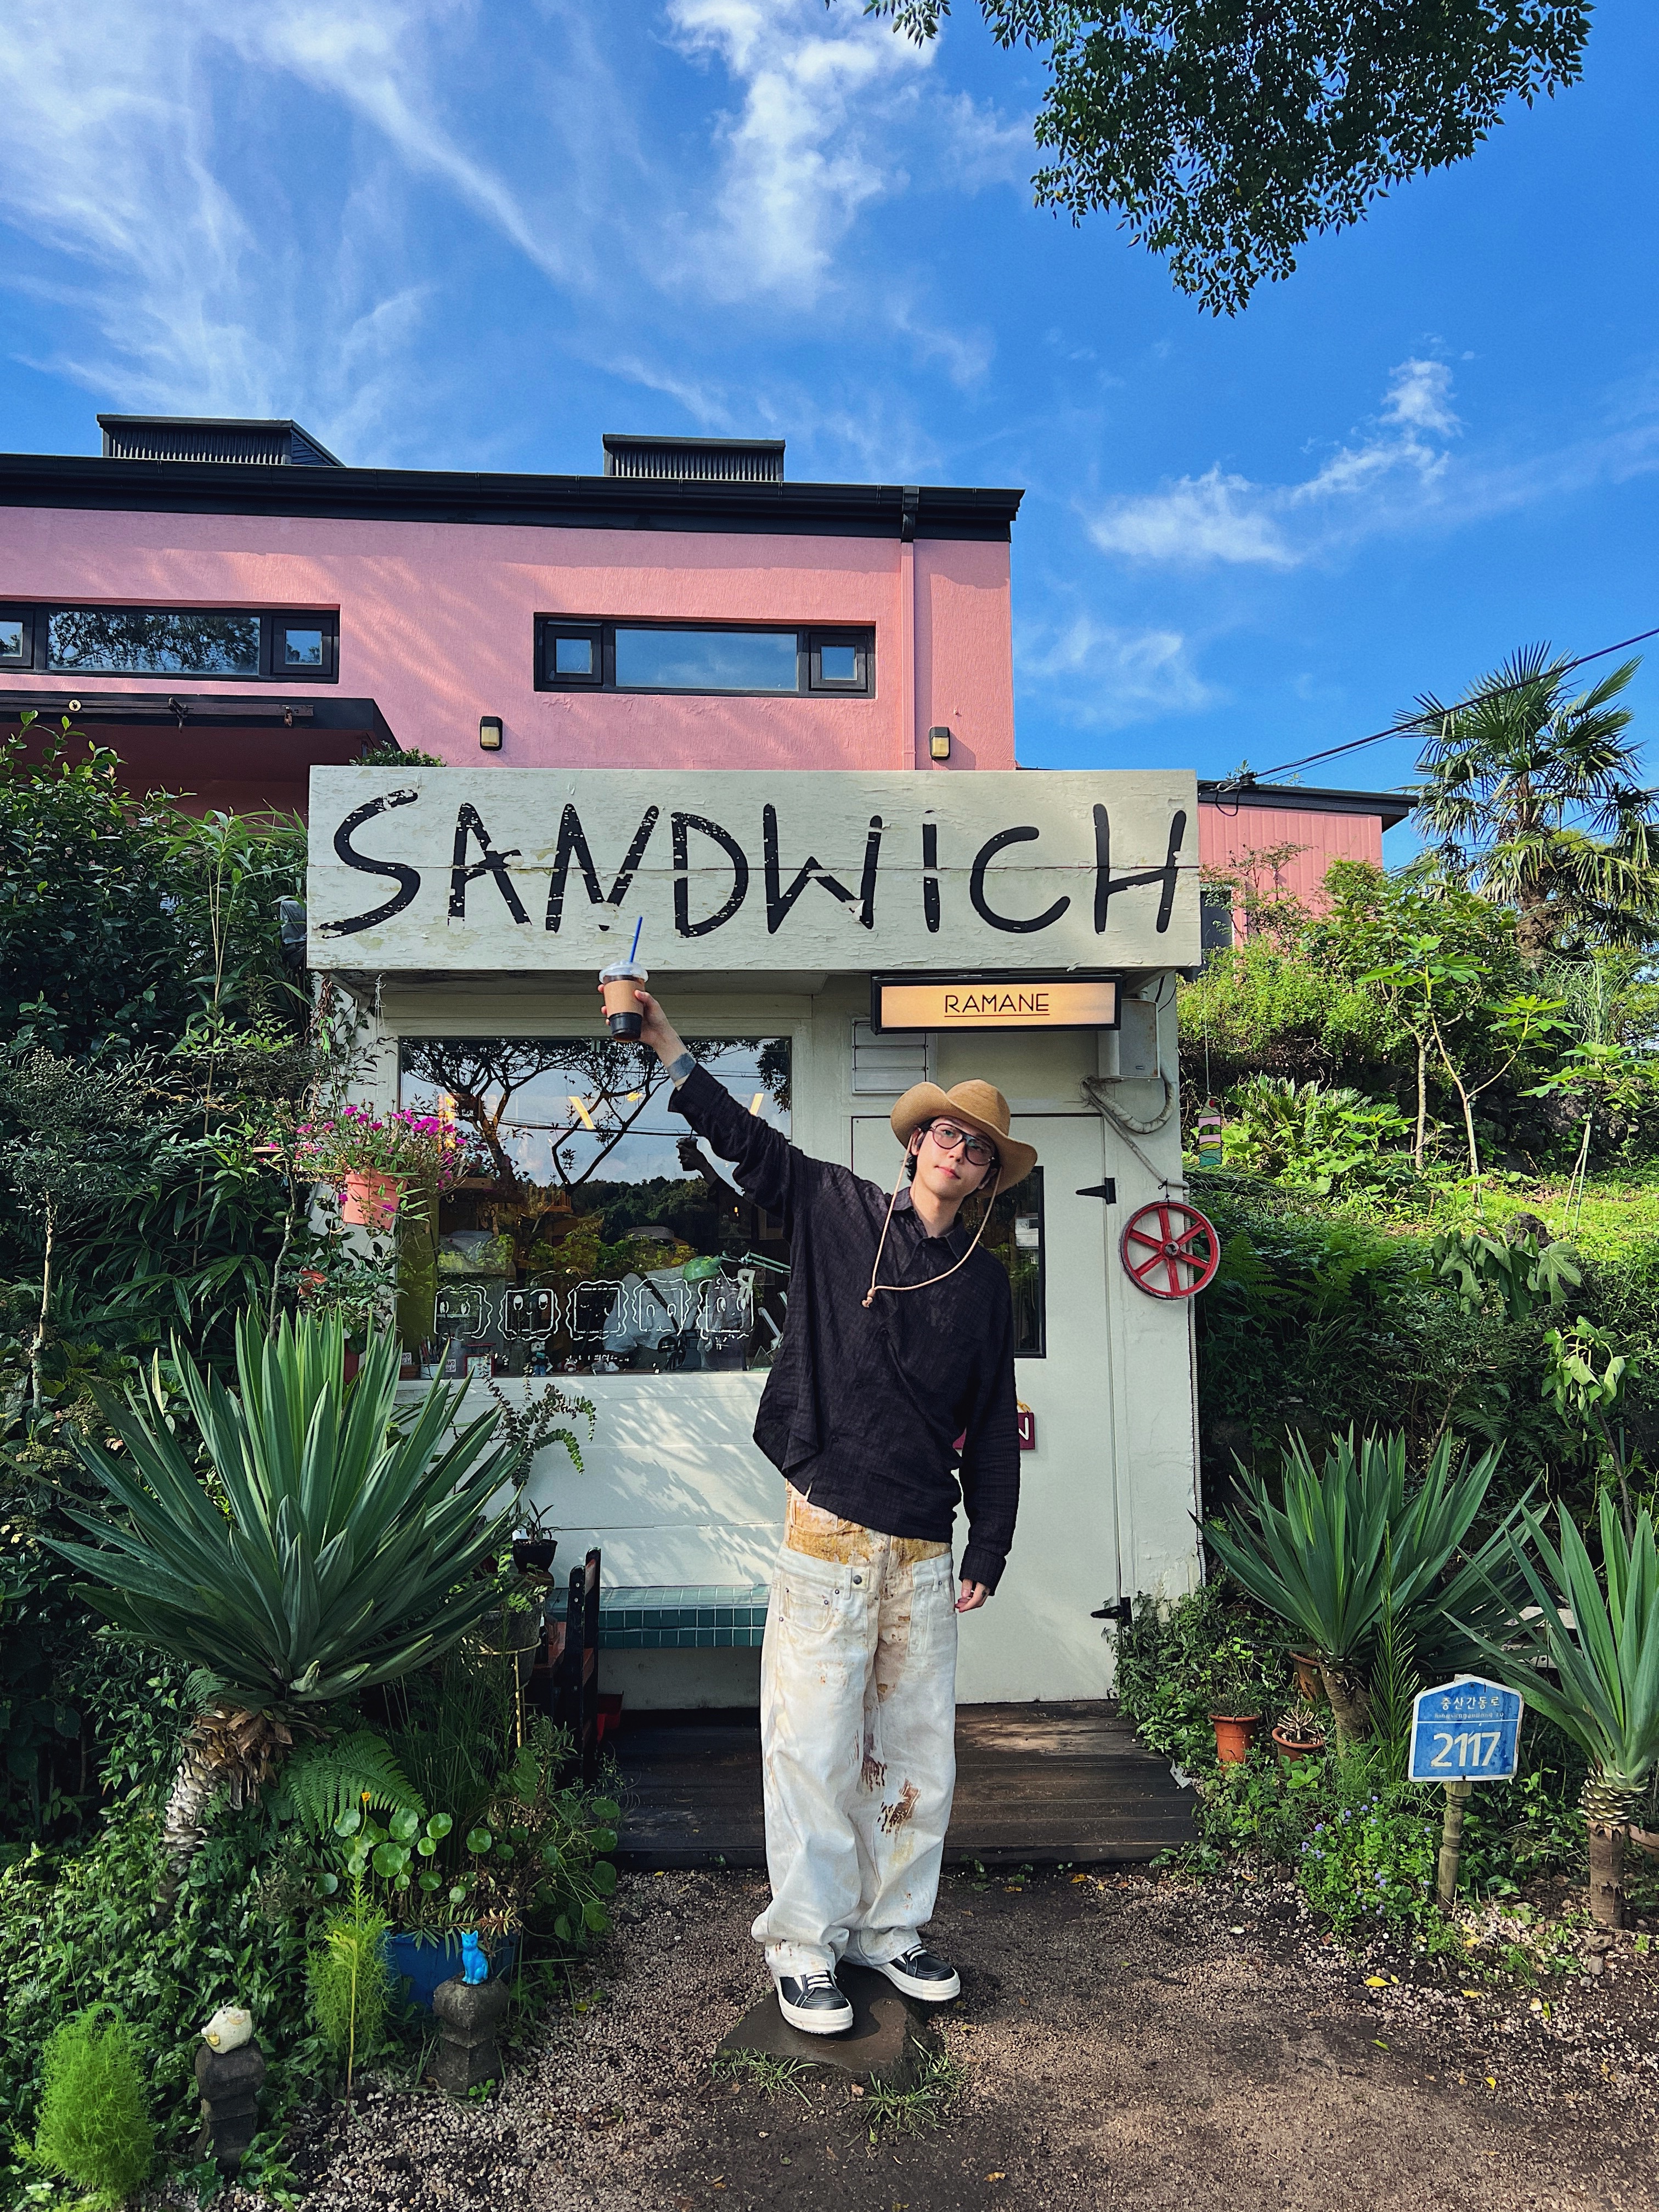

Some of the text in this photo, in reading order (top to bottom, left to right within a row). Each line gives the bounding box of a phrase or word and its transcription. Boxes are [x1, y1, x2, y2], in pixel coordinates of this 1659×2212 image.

[319, 788, 1186, 939] SANDWICH
[945, 993, 1049, 1013] RAMANE
[1441, 1696, 1500, 1711] 중산간동로
[1430, 1732, 1501, 1767] 2117
